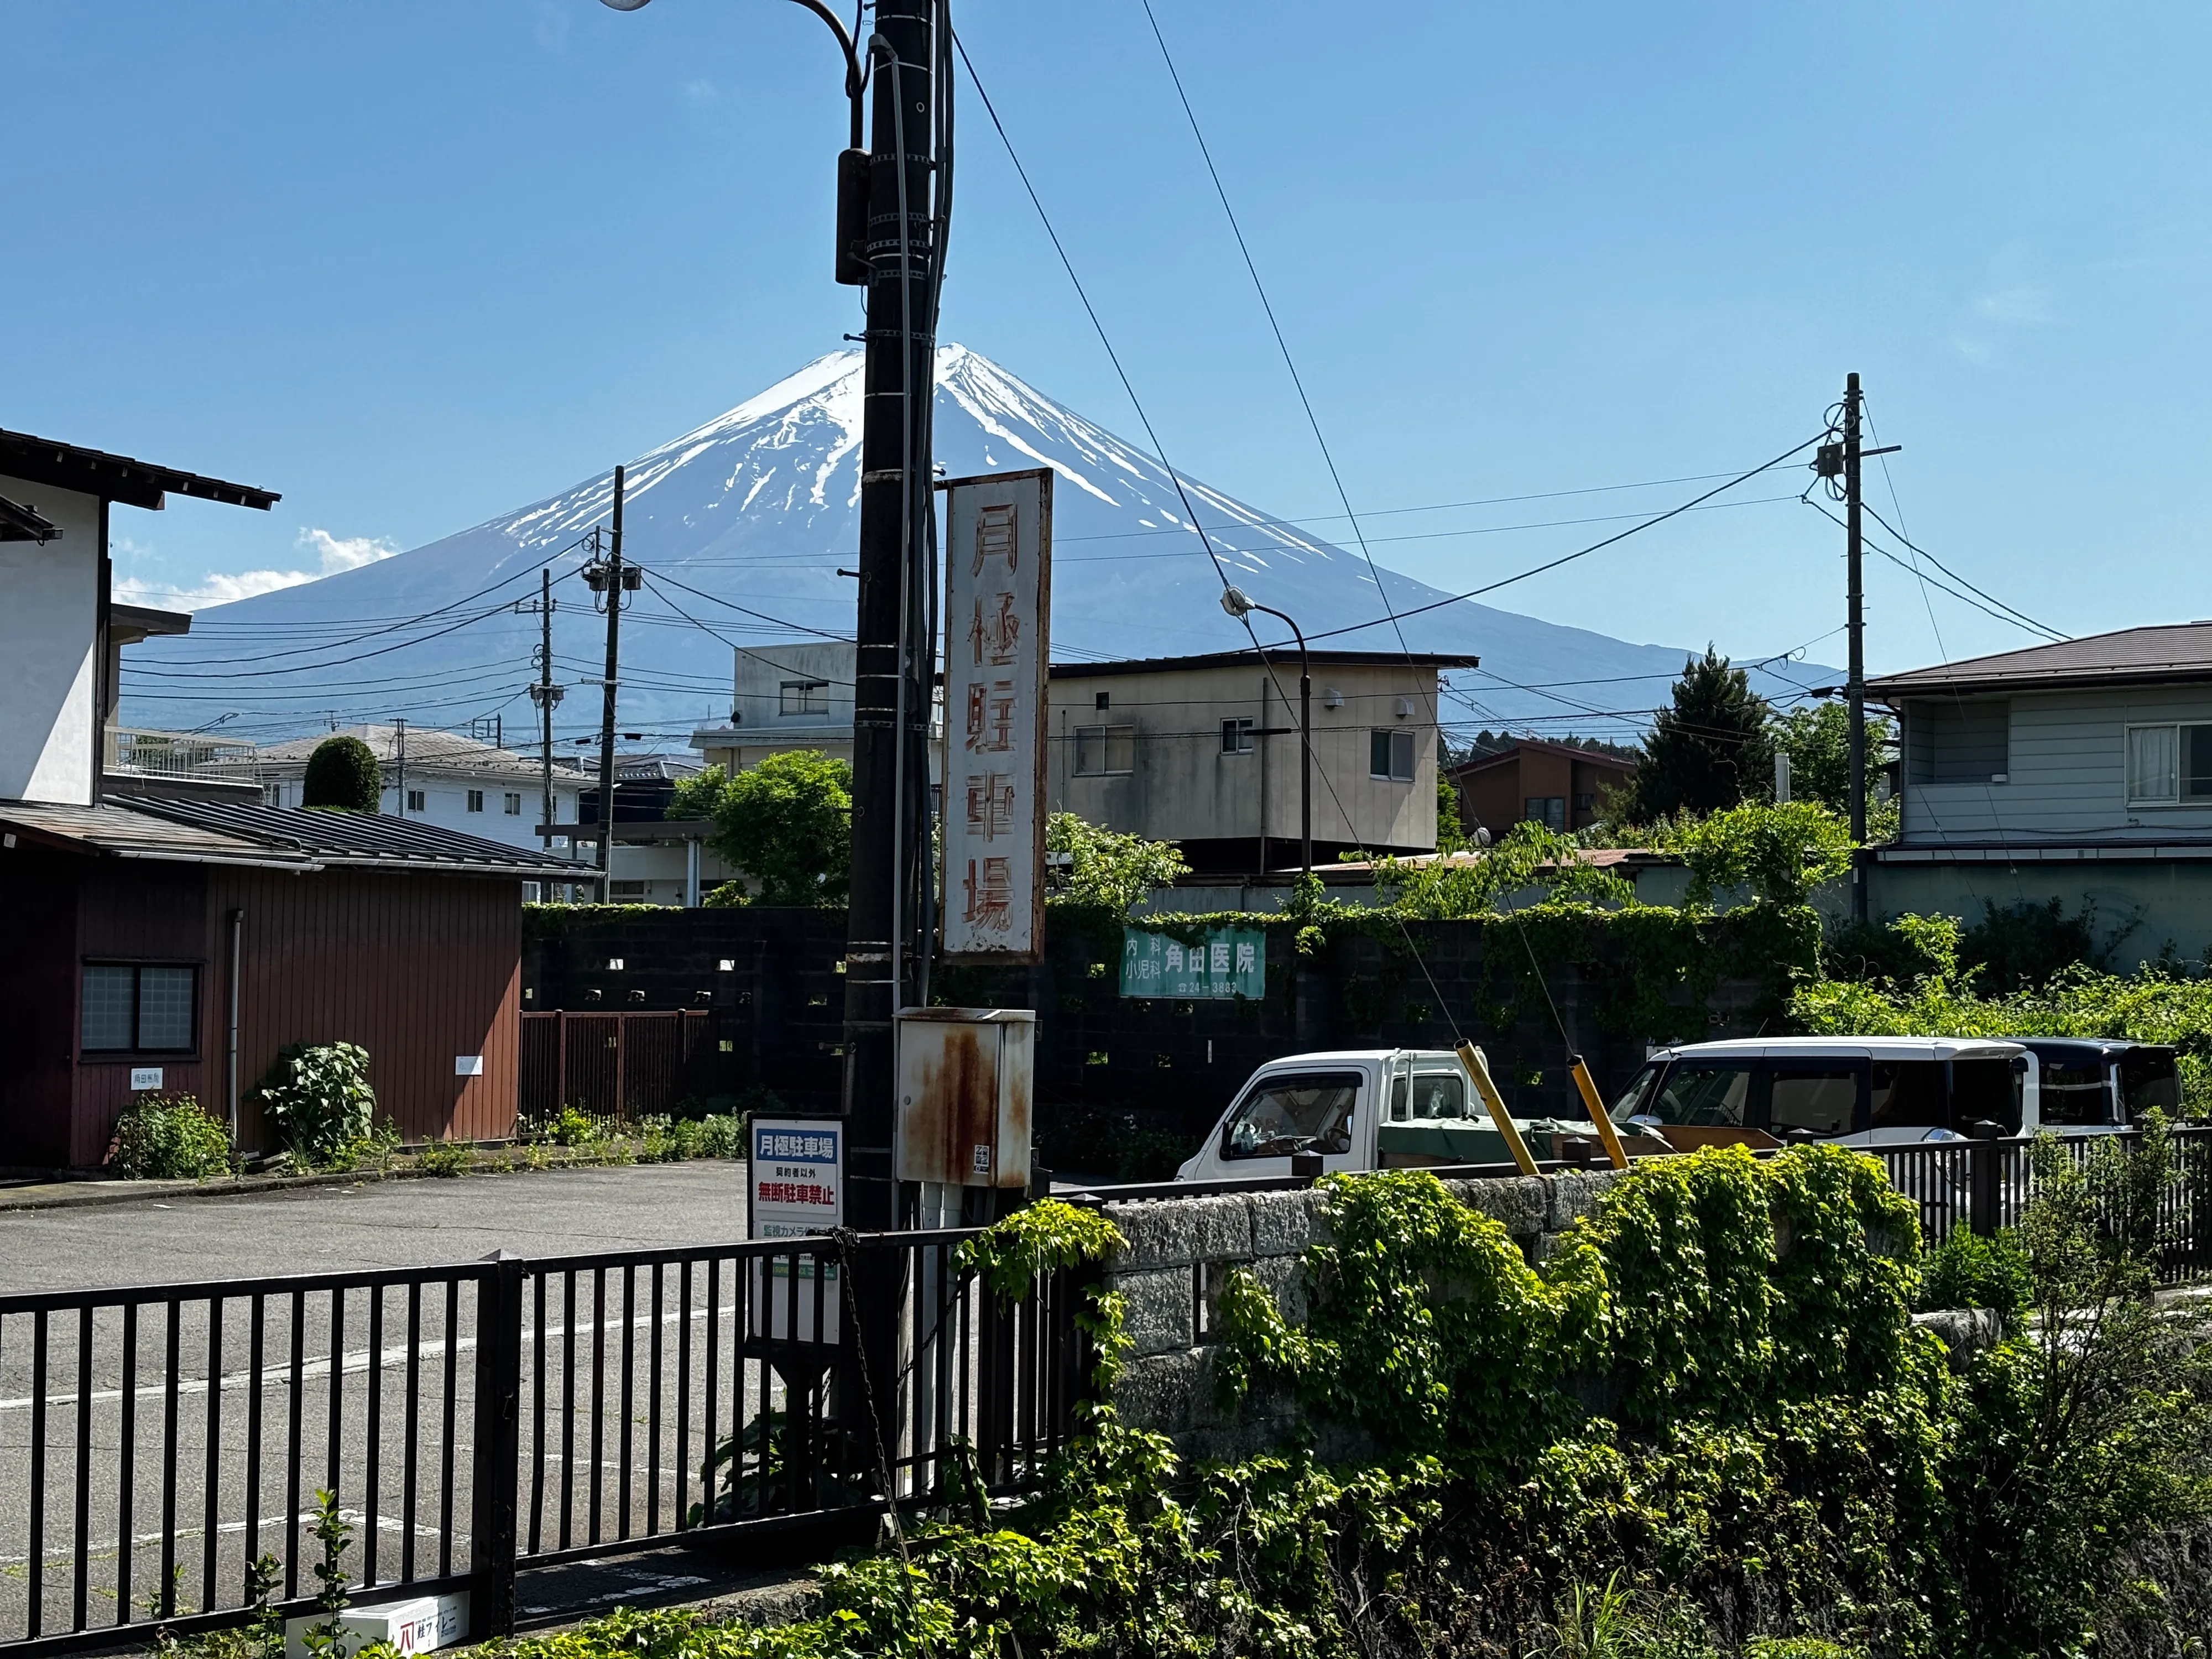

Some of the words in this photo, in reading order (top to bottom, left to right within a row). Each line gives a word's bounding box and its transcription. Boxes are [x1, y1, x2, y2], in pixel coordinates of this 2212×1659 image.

[961, 503, 1019, 932] 月極駐車場
[1125, 959, 1160, 979] 小児科
[1165, 942, 1255, 973] 角田医院
[760, 1135, 834, 1159] 月極駐車場
[776, 1166, 816, 1178] 契約者以外
[758, 1181, 834, 1205] 無断駐車禁止
